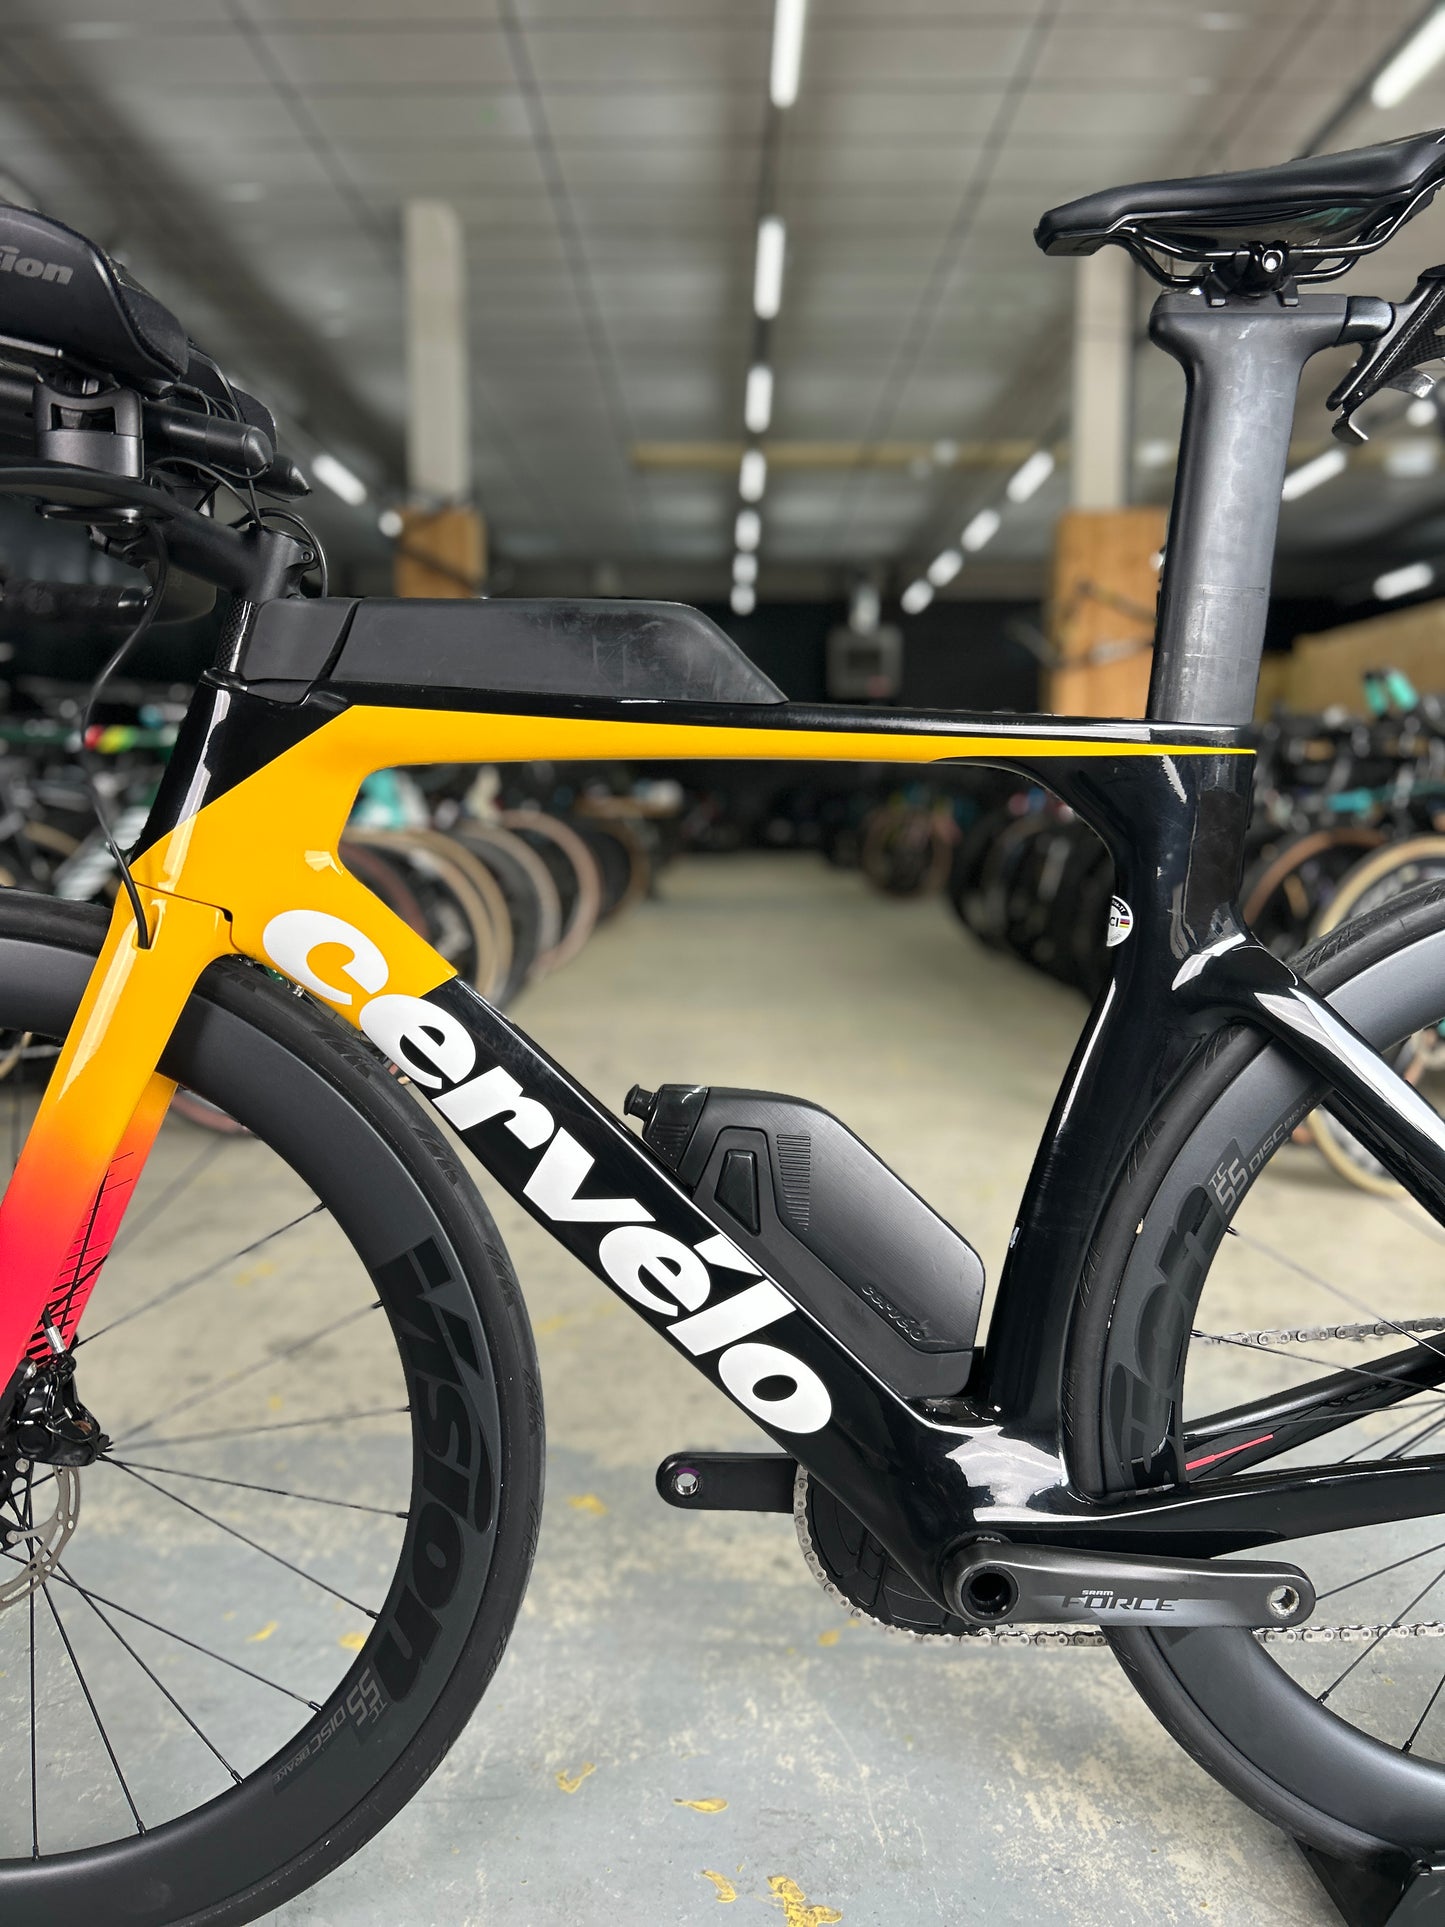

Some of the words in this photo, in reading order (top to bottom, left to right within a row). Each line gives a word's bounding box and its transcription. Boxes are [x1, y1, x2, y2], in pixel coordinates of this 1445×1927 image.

[0, 245, 74, 286] ion
[1208, 1161, 1228, 1188] TC
[1215, 1157, 1249, 1216] 55
[1061, 1595, 1180, 1611] FORCE
[345, 1667, 381, 1727] 55
[368, 1698, 388, 1724] TC
[309, 1705, 347, 1755] DISC
